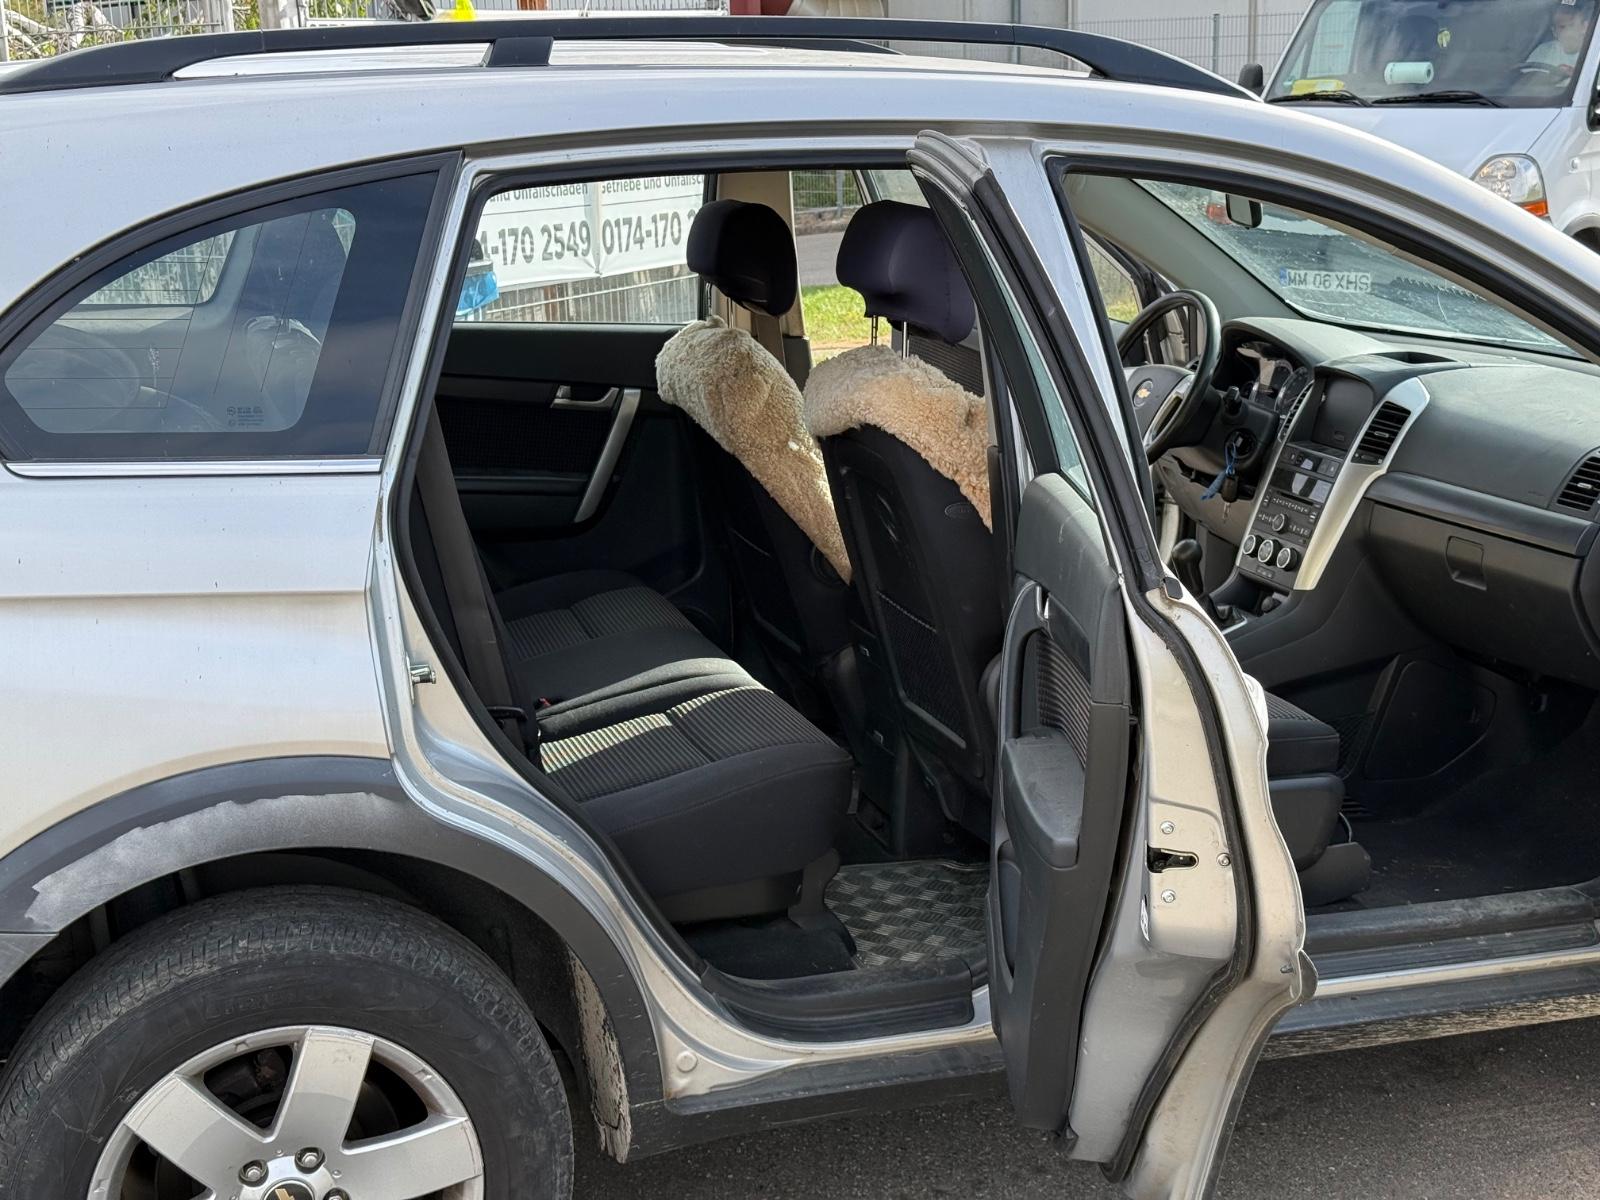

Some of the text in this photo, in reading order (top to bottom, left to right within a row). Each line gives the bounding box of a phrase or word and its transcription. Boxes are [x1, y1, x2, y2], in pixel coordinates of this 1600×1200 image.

[664, 174, 704, 188] Unfallsc
[540, 220, 591, 261] 2549
[602, 211, 682, 256] 0174-170
